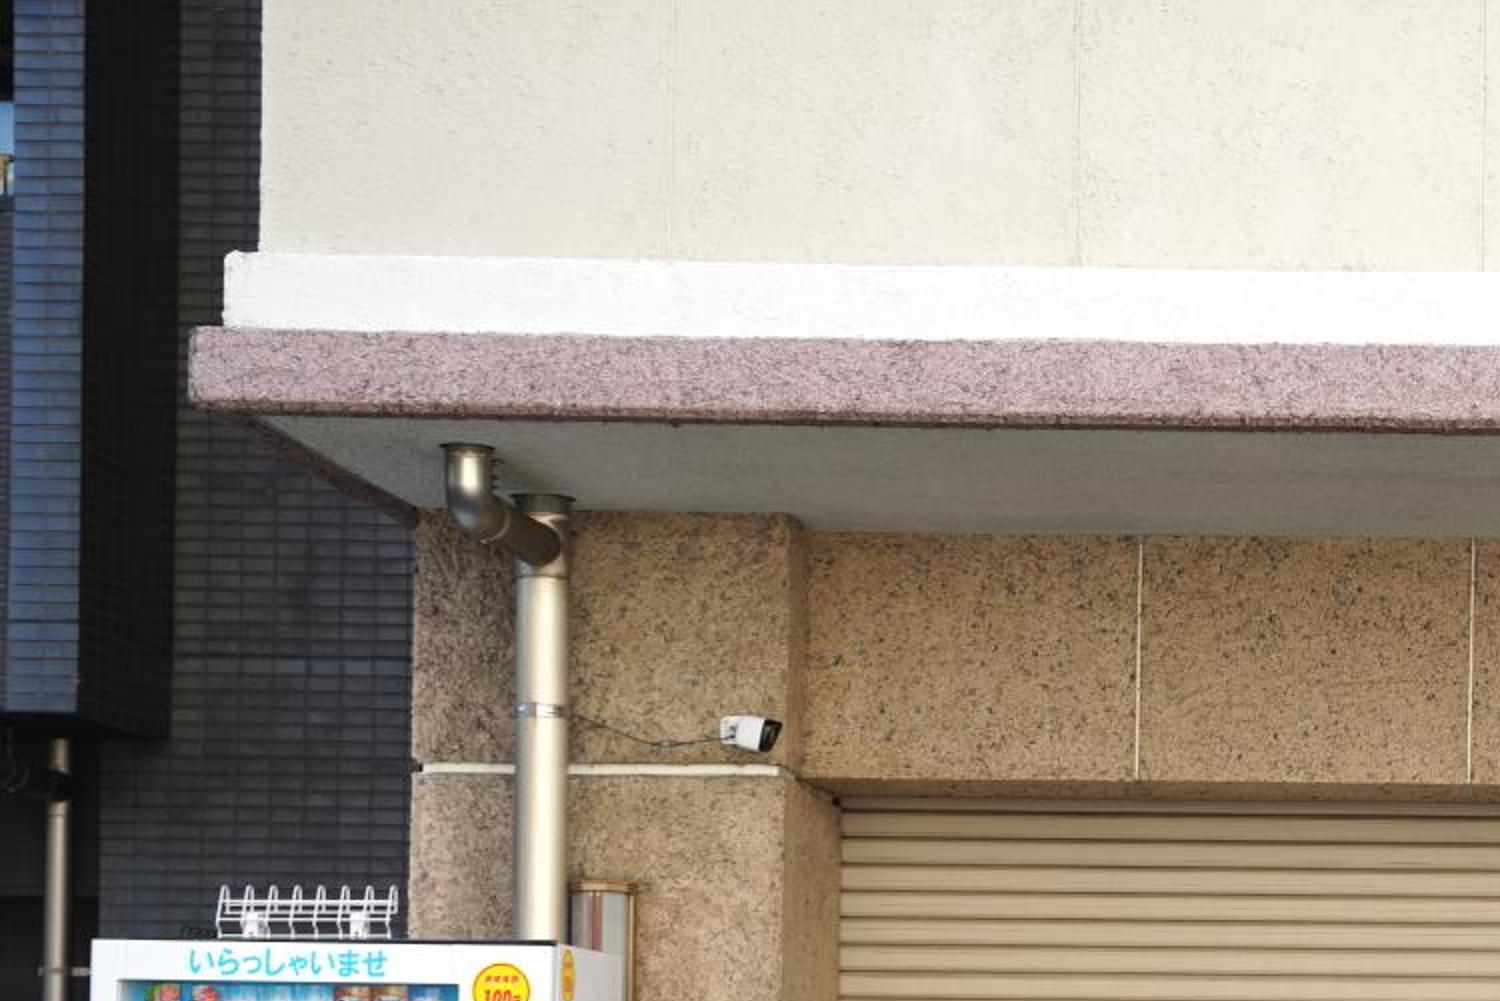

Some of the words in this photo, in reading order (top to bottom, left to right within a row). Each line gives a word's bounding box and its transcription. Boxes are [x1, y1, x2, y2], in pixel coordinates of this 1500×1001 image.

[189, 948, 388, 978] いらっしゃいませ
